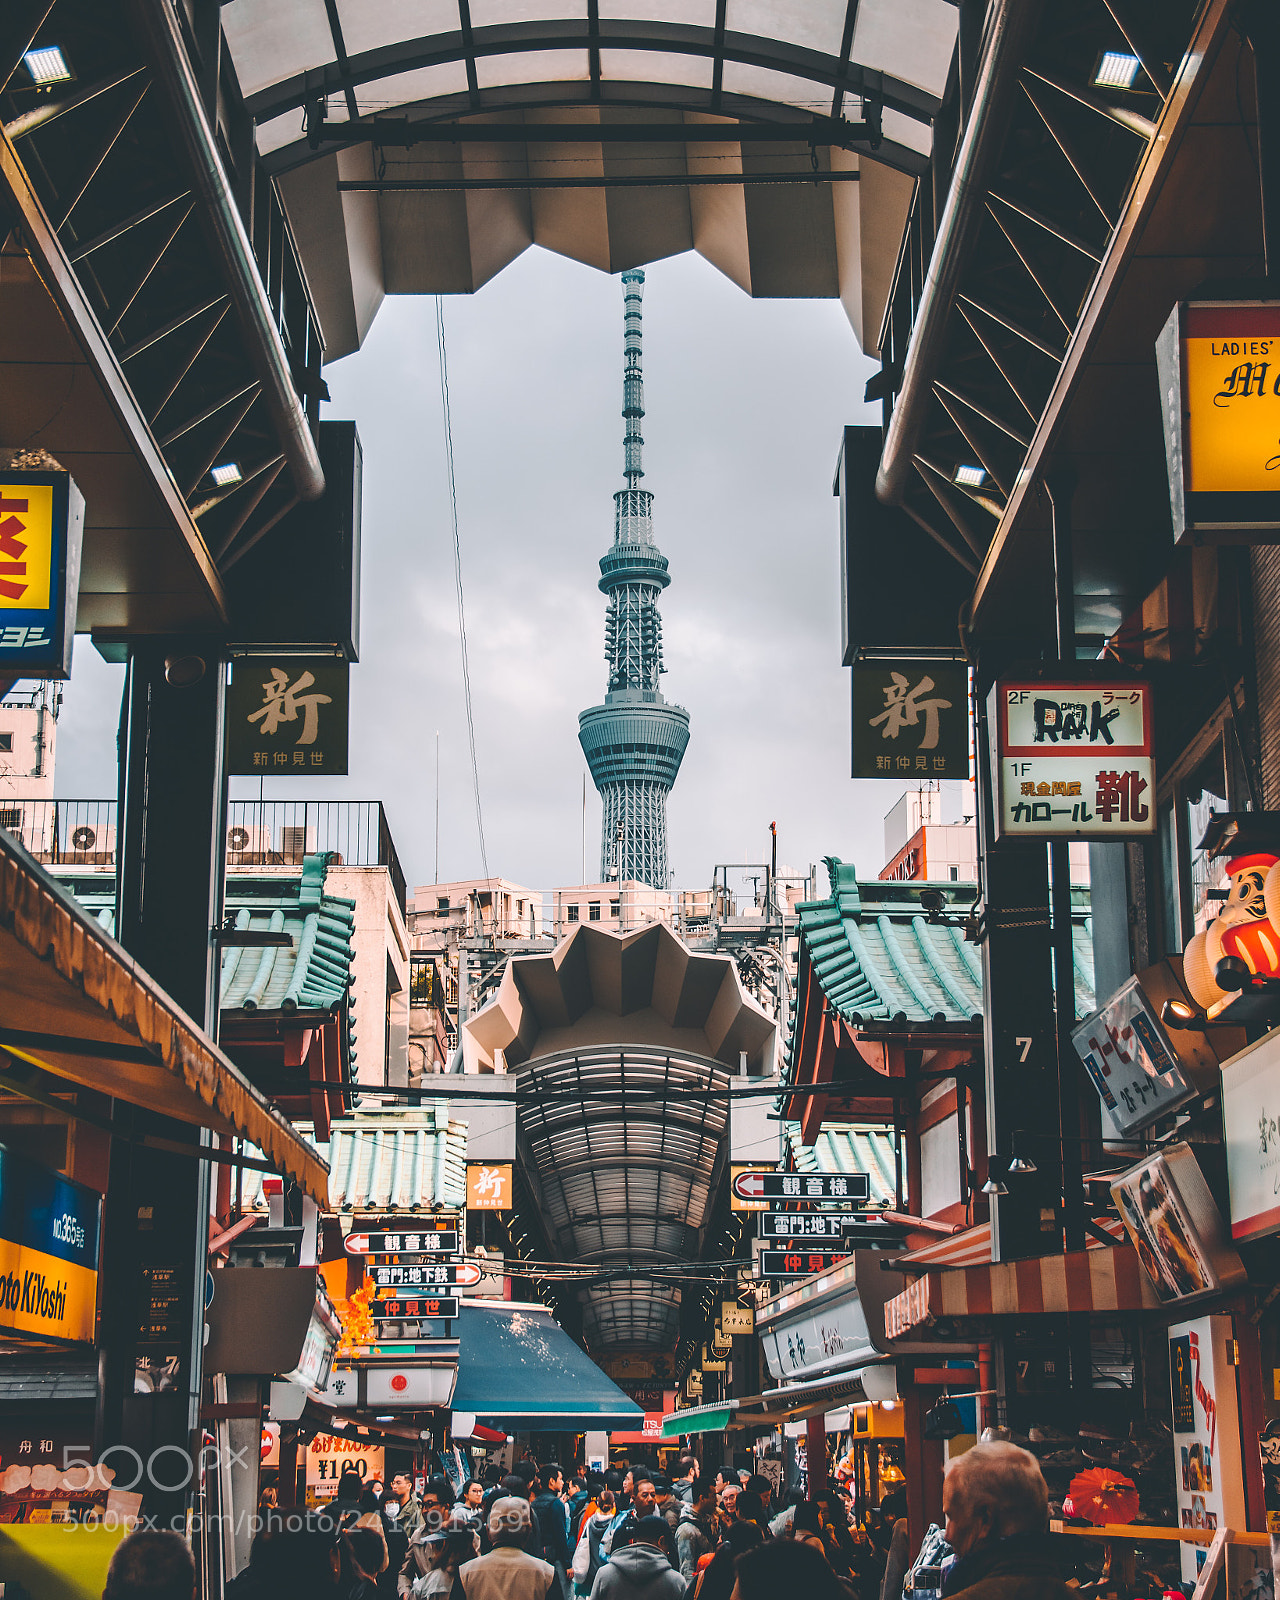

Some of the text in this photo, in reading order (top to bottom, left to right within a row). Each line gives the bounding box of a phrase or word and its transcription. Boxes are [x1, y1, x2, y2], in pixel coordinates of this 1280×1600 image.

[1211, 340, 1273, 355] LADIES'
[0, 626, 51, 648] ヨシ
[247, 667, 332, 745] 新
[1008, 691, 1031, 704] 2F
[1102, 691, 1141, 705] ラーク
[868, 671, 952, 749] 新
[253, 751, 324, 766] 新仲見世
[876, 755, 946, 771] 新仲見世
[1010, 763, 1032, 777] 1F
[1020, 781, 1082, 796] 現金問屋
[1095, 770, 1148, 822] 靴
[1010, 801, 1094, 822] カロール
[1015, 1036, 1032, 1063] 7
[473, 1166, 506, 1198] 新
[782, 1177, 848, 1195] 観音様
[384, 1234, 441, 1251] 観音様
[384, 1300, 440, 1317] 仲見世
[139, 1355, 178, 1374] 北 7
[1018, 1361, 1055, 1378] 7 南
[332, 1379, 346, 1395] 堂
[18, 1439, 54, 1454] 舟和
